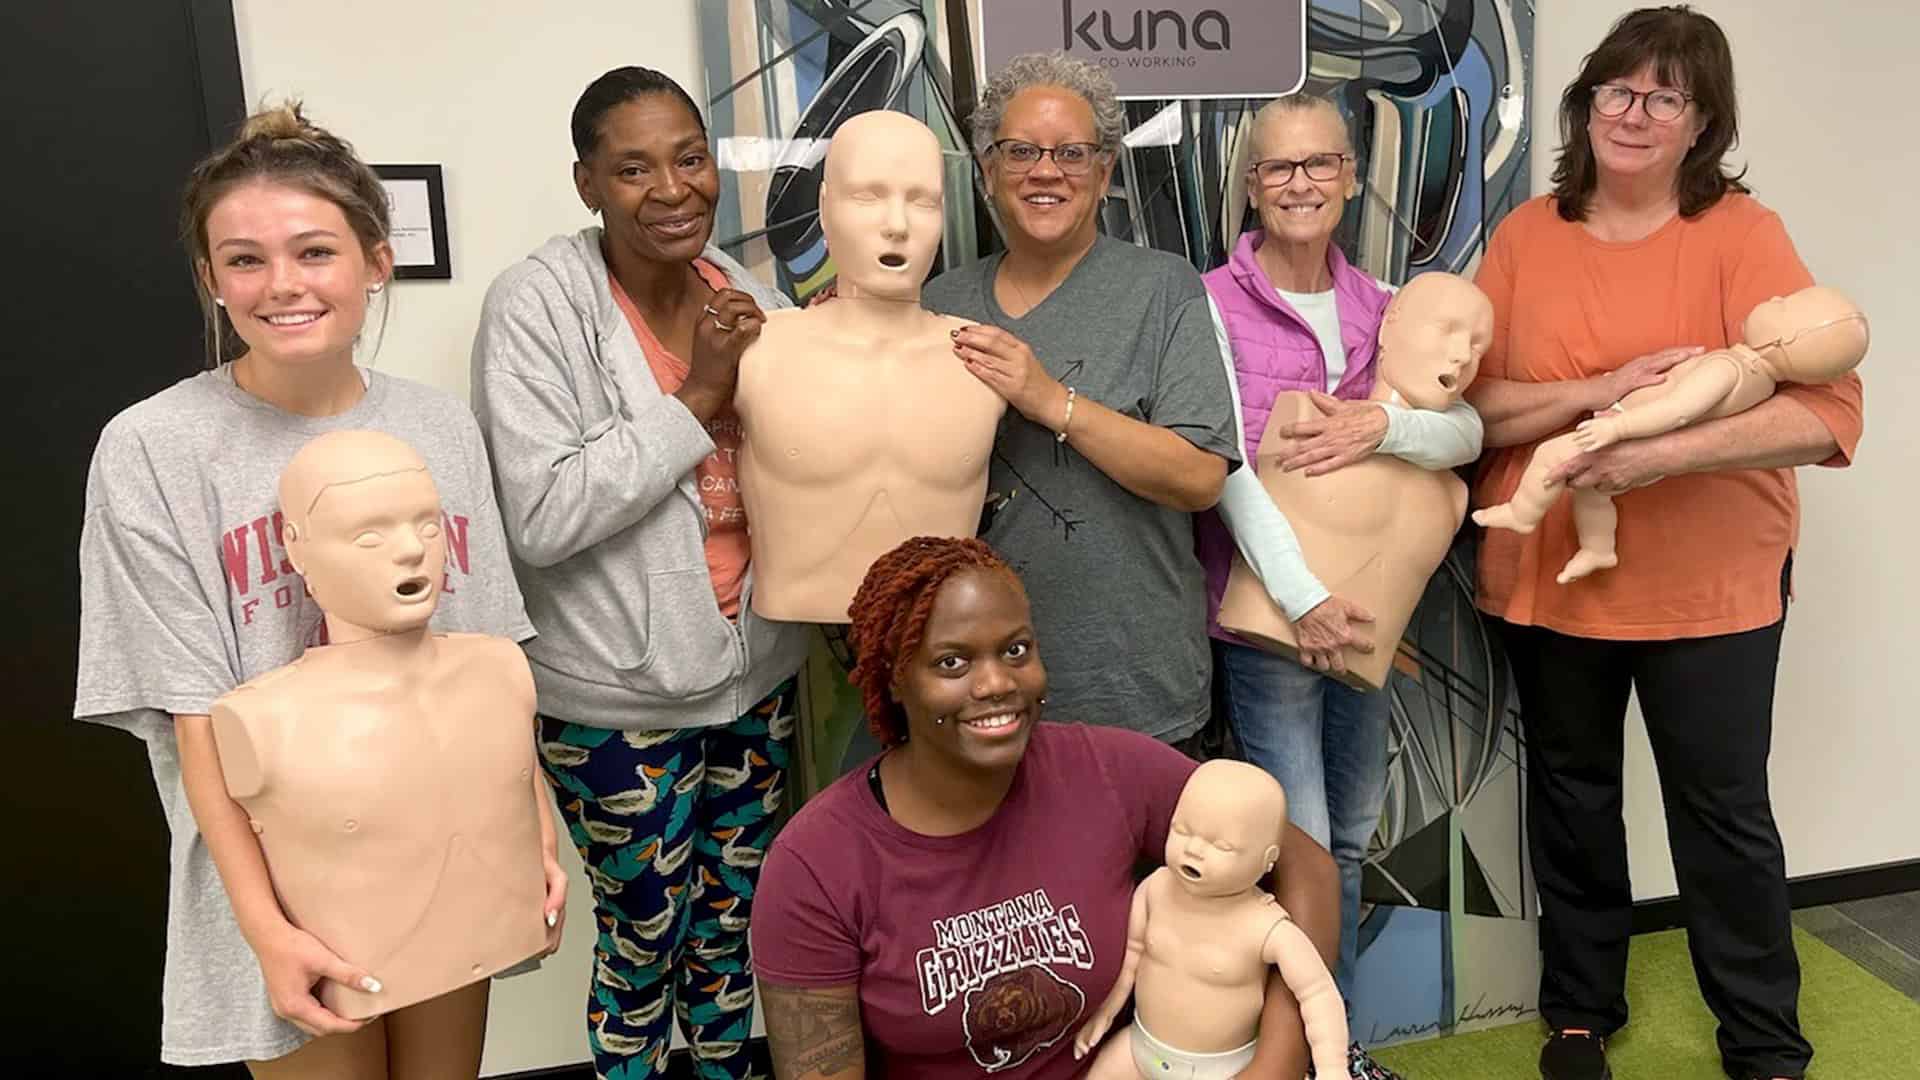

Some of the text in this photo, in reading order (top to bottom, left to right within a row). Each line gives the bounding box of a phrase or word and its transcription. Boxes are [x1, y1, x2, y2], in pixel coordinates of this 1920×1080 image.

[1062, 0, 1230, 51] kuna
[932, 888, 1056, 949] MONTANA
[915, 903, 1095, 1016] GRIZZLIES
